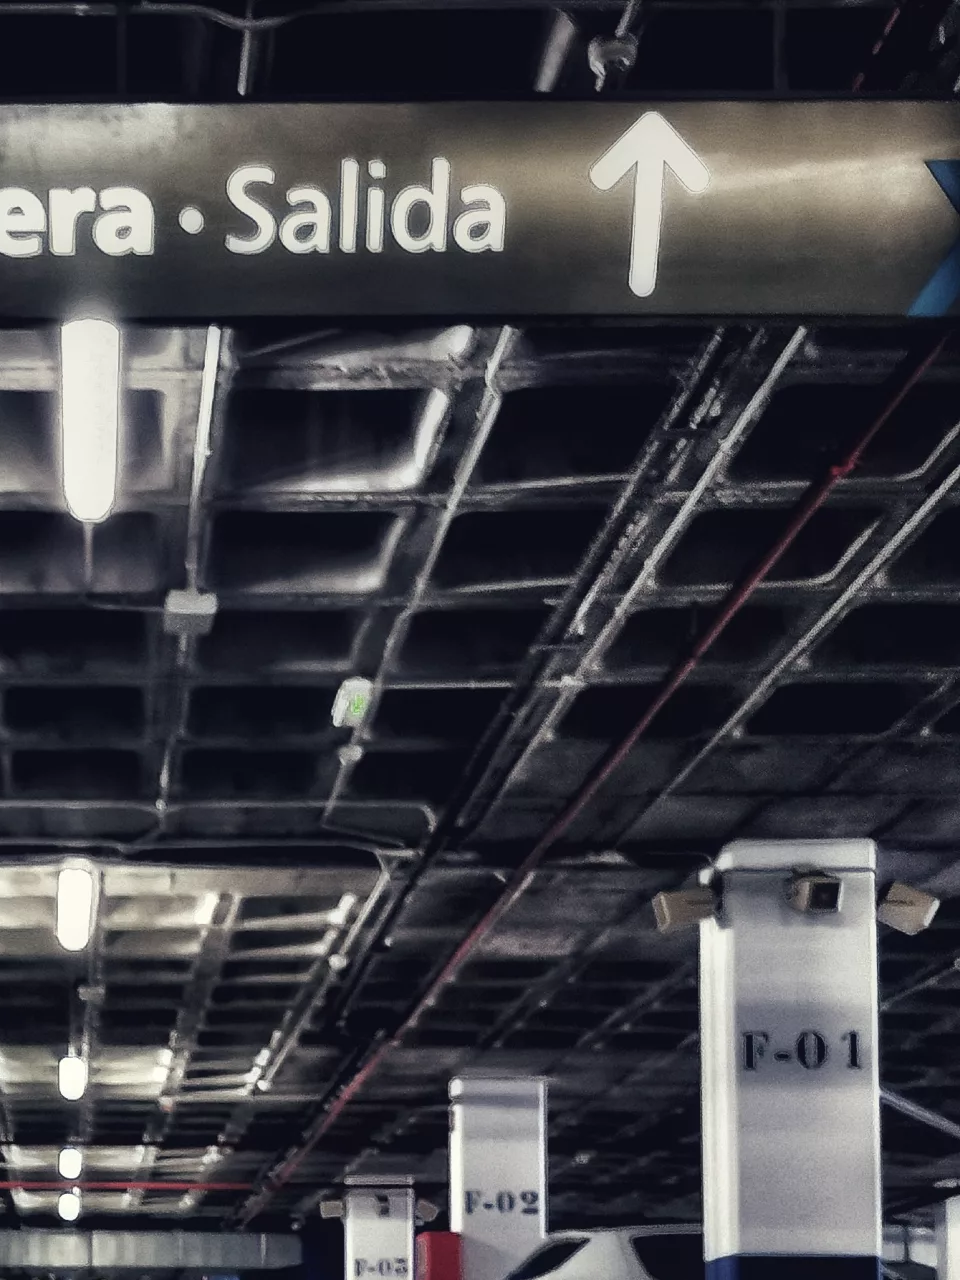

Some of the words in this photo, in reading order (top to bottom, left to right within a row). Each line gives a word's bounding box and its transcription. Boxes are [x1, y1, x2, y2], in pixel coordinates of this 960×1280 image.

[224, 156, 508, 255] Salida
[743, 1031, 862, 1070] F-01
[464, 1190, 540, 1215] F-02
